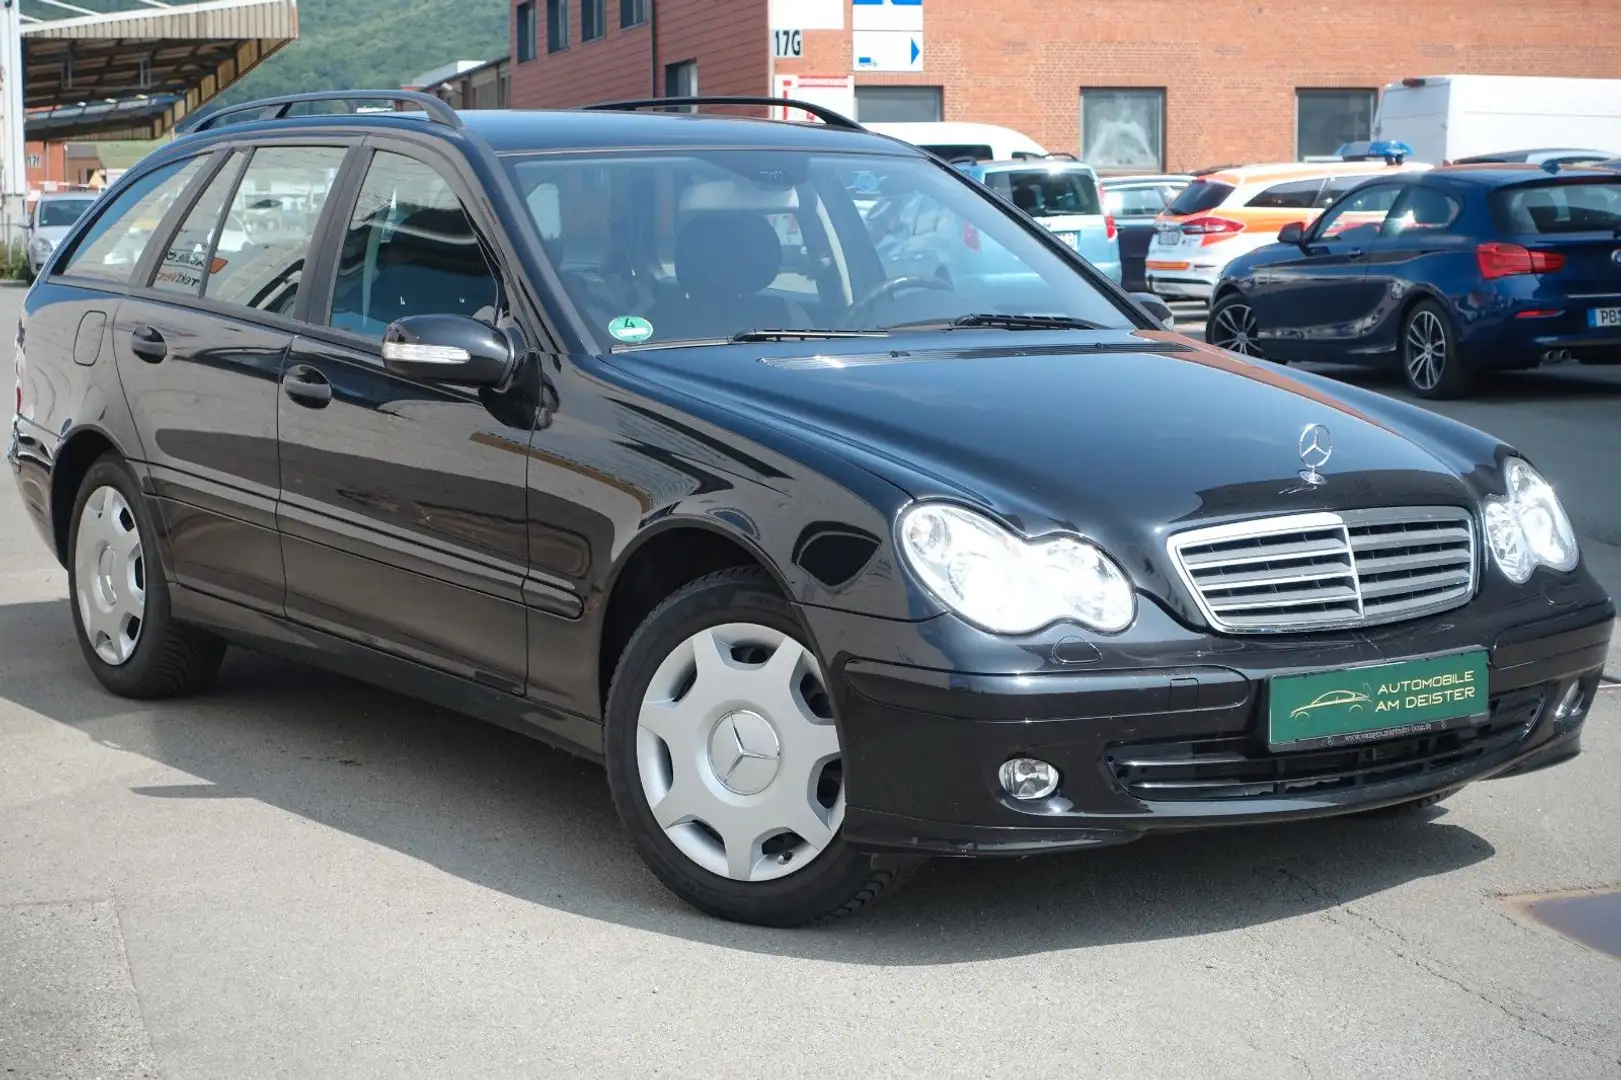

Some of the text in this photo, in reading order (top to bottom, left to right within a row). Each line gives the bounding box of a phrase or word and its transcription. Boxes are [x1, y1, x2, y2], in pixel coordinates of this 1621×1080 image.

[775, 29, 801, 56] 17G
[624, 317, 635, 328] 4
[1600, 309, 1617, 324] PB
[1377, 670, 1475, 695] AUTOMOBILE
[1375, 686, 1475, 713] AM DEISTER
